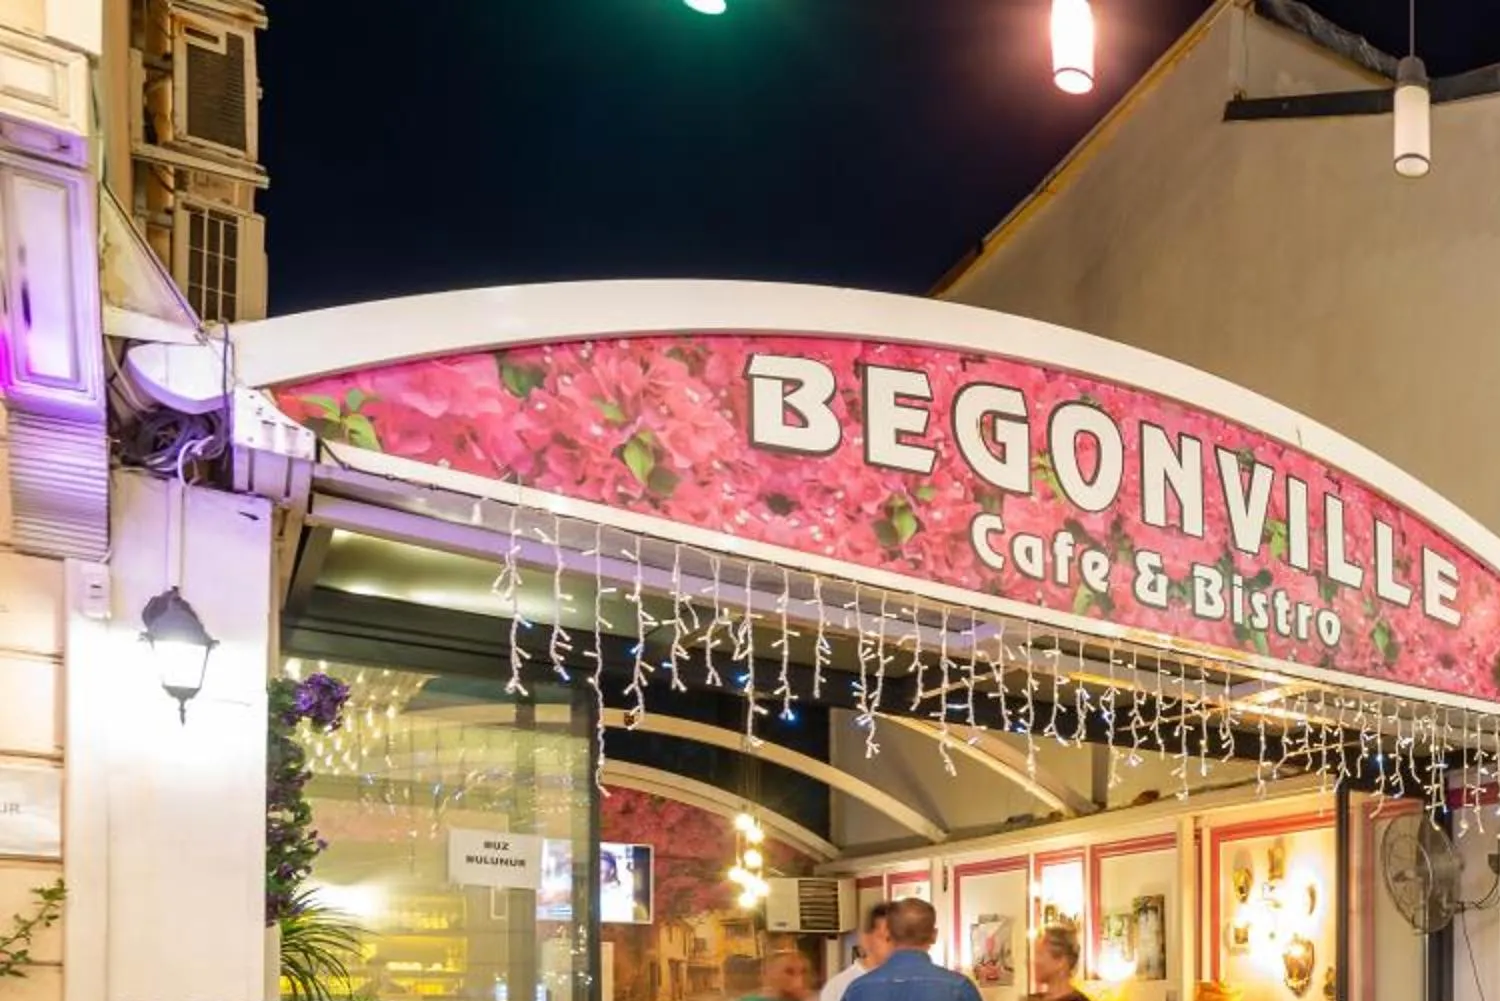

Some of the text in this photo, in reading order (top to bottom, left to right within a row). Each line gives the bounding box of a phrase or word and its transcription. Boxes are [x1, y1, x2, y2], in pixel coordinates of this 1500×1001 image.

[745, 353, 1462, 628] BEGONVILLE
[969, 512, 1343, 647] Cafe & Bistro
